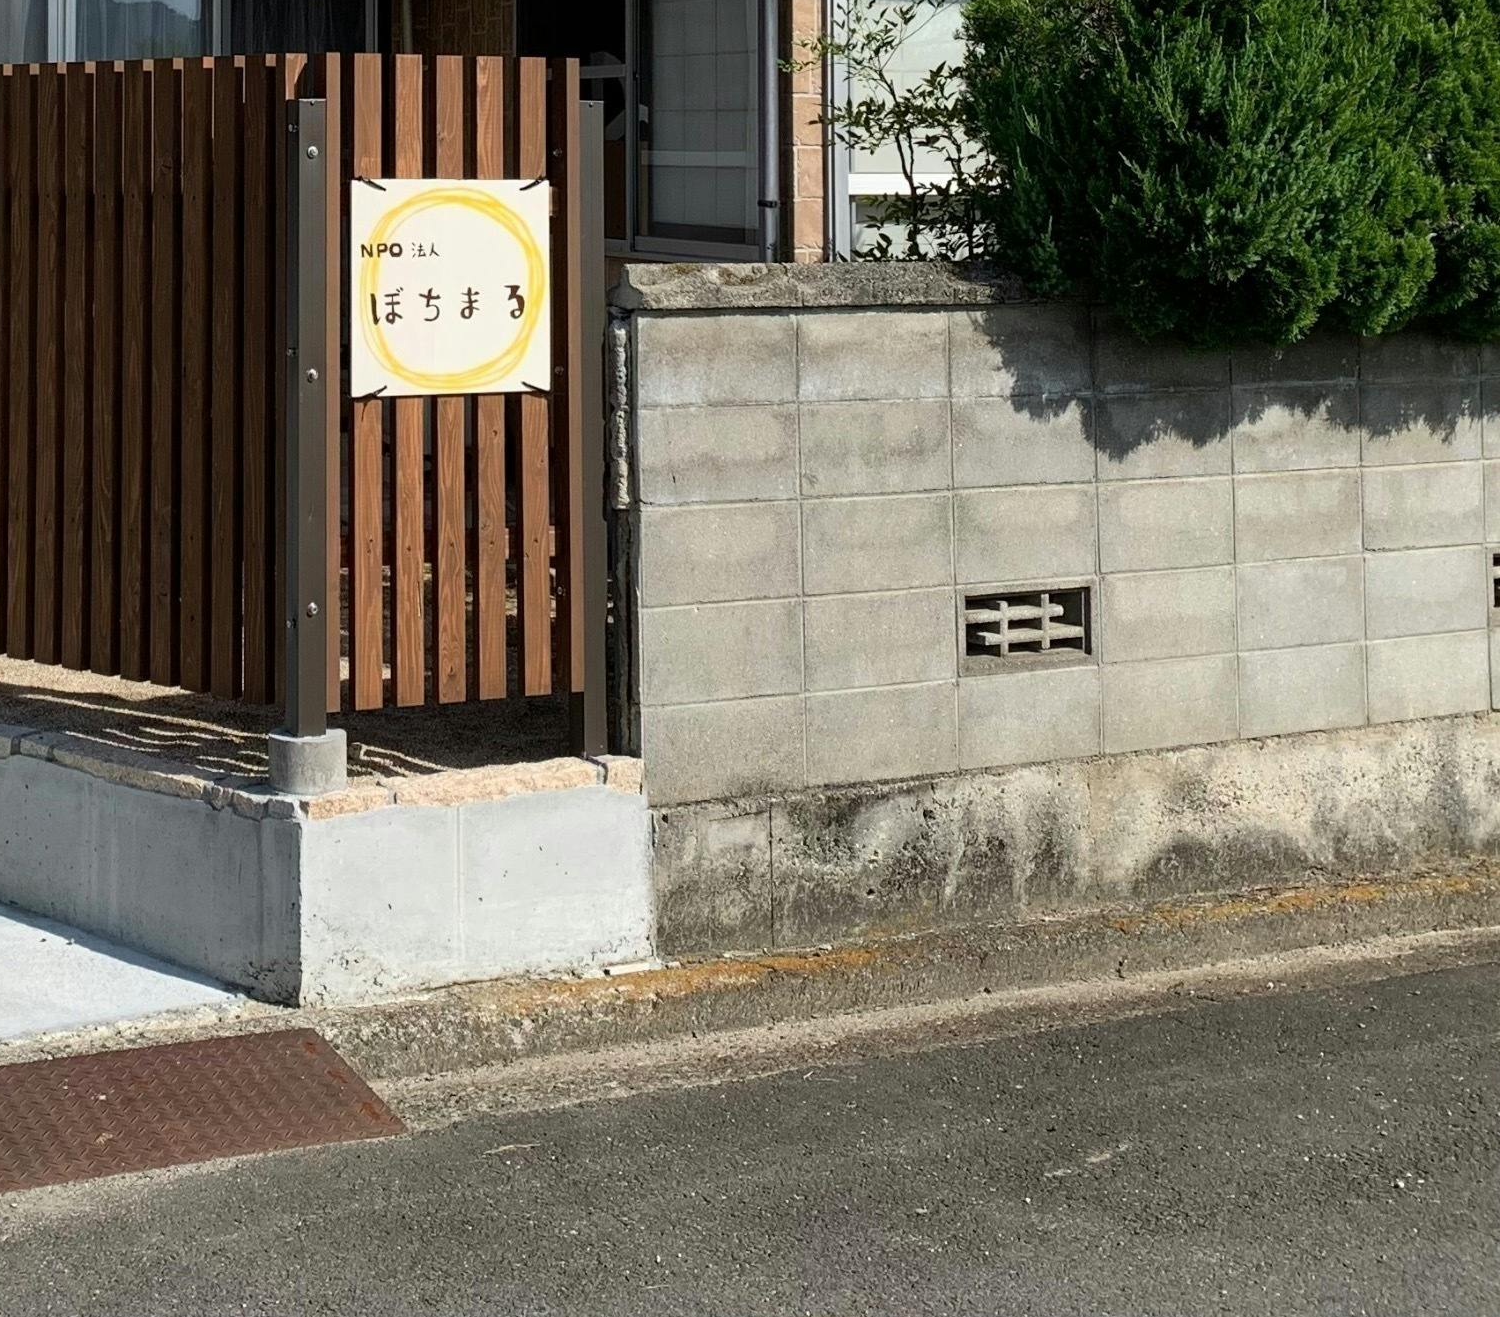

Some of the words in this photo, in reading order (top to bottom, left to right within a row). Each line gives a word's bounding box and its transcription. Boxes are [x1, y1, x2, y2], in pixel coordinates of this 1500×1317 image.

[360, 242, 403, 258] NPO
[411, 242, 440, 259] 法人
[370, 285, 526, 325] ぼちまる
